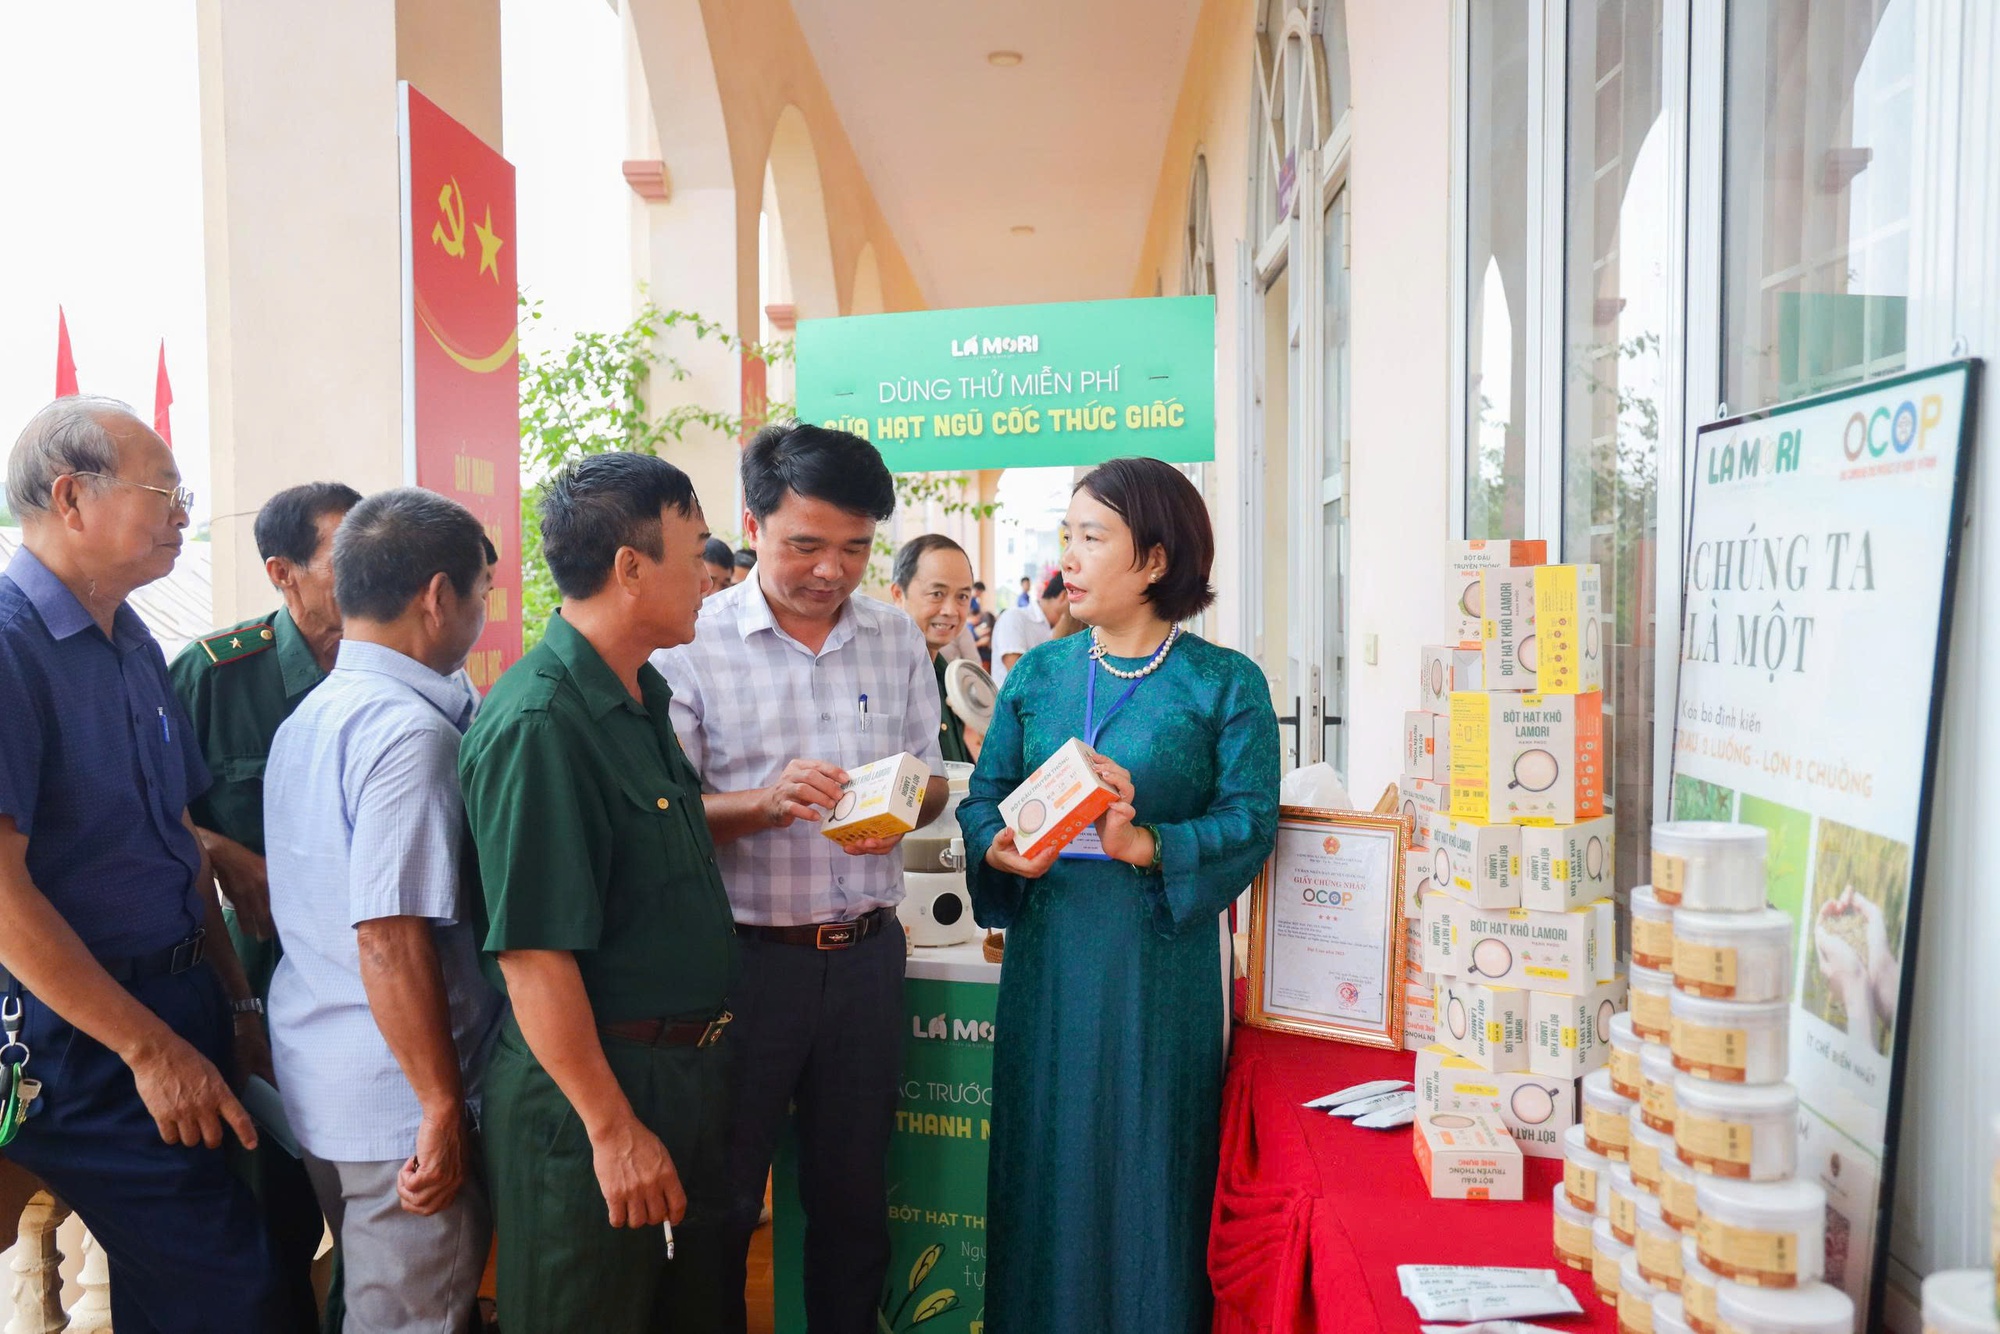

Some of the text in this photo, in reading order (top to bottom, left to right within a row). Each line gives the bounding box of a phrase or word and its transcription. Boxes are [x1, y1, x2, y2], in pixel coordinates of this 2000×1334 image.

[951, 334, 1039, 357] LÁ MORI
[878, 364, 1121, 404] DÙNG THỬ MIỄN PHÍ
[877, 414, 925, 444] HẠT
[933, 411, 983, 437] NGŨ
[992, 403, 1040, 435] CỐC
[1048, 399, 1117, 432] THỨC
[1125, 397, 1185, 429] GIẤC
[1843, 394, 1943, 462] OCOP
[1693, 522, 1876, 592] CHÚNG TA
[1499, 582, 1514, 676] BỘT HẠT KHÔ LAMORI
[1686, 597, 1815, 683] LÀ MỘT
[1503, 709, 1562, 725] BỘT HẠT KHÔ
[1701, 701, 1713, 723] bỏ
[1715, 705, 1736, 729] định
[1740, 707, 1761, 733] kiến
[1515, 726, 1550, 738] LAMORI
[1679, 728, 1698, 752] RAU
[1795, 758, 1803, 780] 2
[1293, 874, 1313, 885] GIẤY
[1489, 854, 1497, 880] LAMORI
[1499, 844, 1509, 888] BỘT HẠT KHÔ
[1530, 855, 1539, 881] LAMORI
[1540, 847, 1551, 891] BỘT HẠT KHÔ
[1303, 888, 1353, 906] OCOP
[1470, 919, 1568, 941] BỘT HẠT KHÔ LAMORI
[913, 1012, 995, 1042] LÁ MO
[1505, 1010, 1514, 1054] BỘT HẠT KHÔ
[1515, 1018, 1523, 1044] LAMORI
[1540, 1021, 1548, 1047] LAMORI
[1550, 1013, 1560, 1058] BỘT HẠT KHÔ
[895, 1111, 972, 1139] THANH
[1516, 1128, 1535, 1141] HẠT
[1537, 1131, 1556, 1144] BỘT
[1479, 1177, 1494, 1185] BỘT
[888, 1204, 921, 1224] BỘT
[926, 1210, 958, 1229] HẠT
